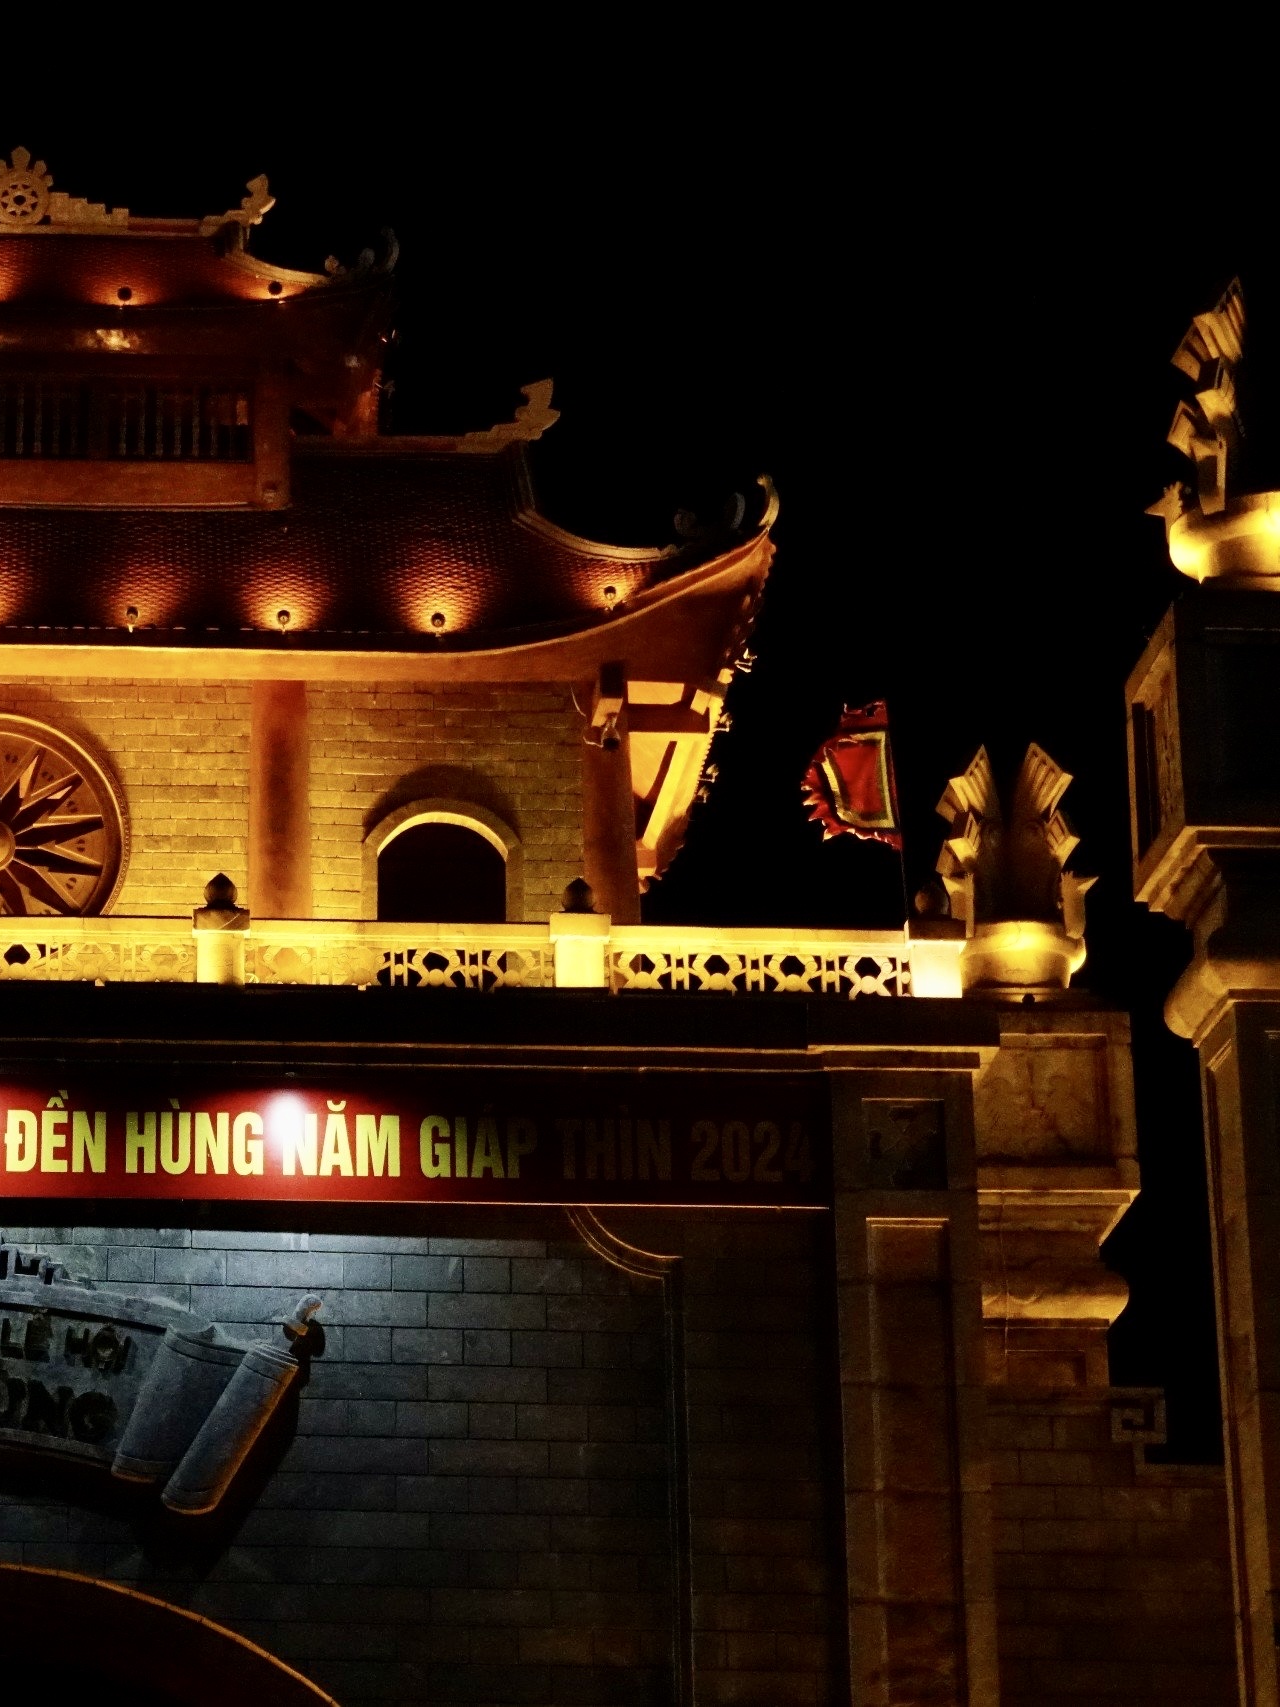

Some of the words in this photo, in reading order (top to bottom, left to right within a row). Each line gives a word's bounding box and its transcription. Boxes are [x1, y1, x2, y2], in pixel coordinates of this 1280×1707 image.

[4, 1089, 107, 1173] ĐỀN
[125, 1098, 264, 1176] HÙNG
[282, 1100, 401, 1177] NĂM
[420, 1103, 538, 1179] GIÁP
[555, 1104, 673, 1182] THÌN
[690, 1119, 815, 1183] 2024
